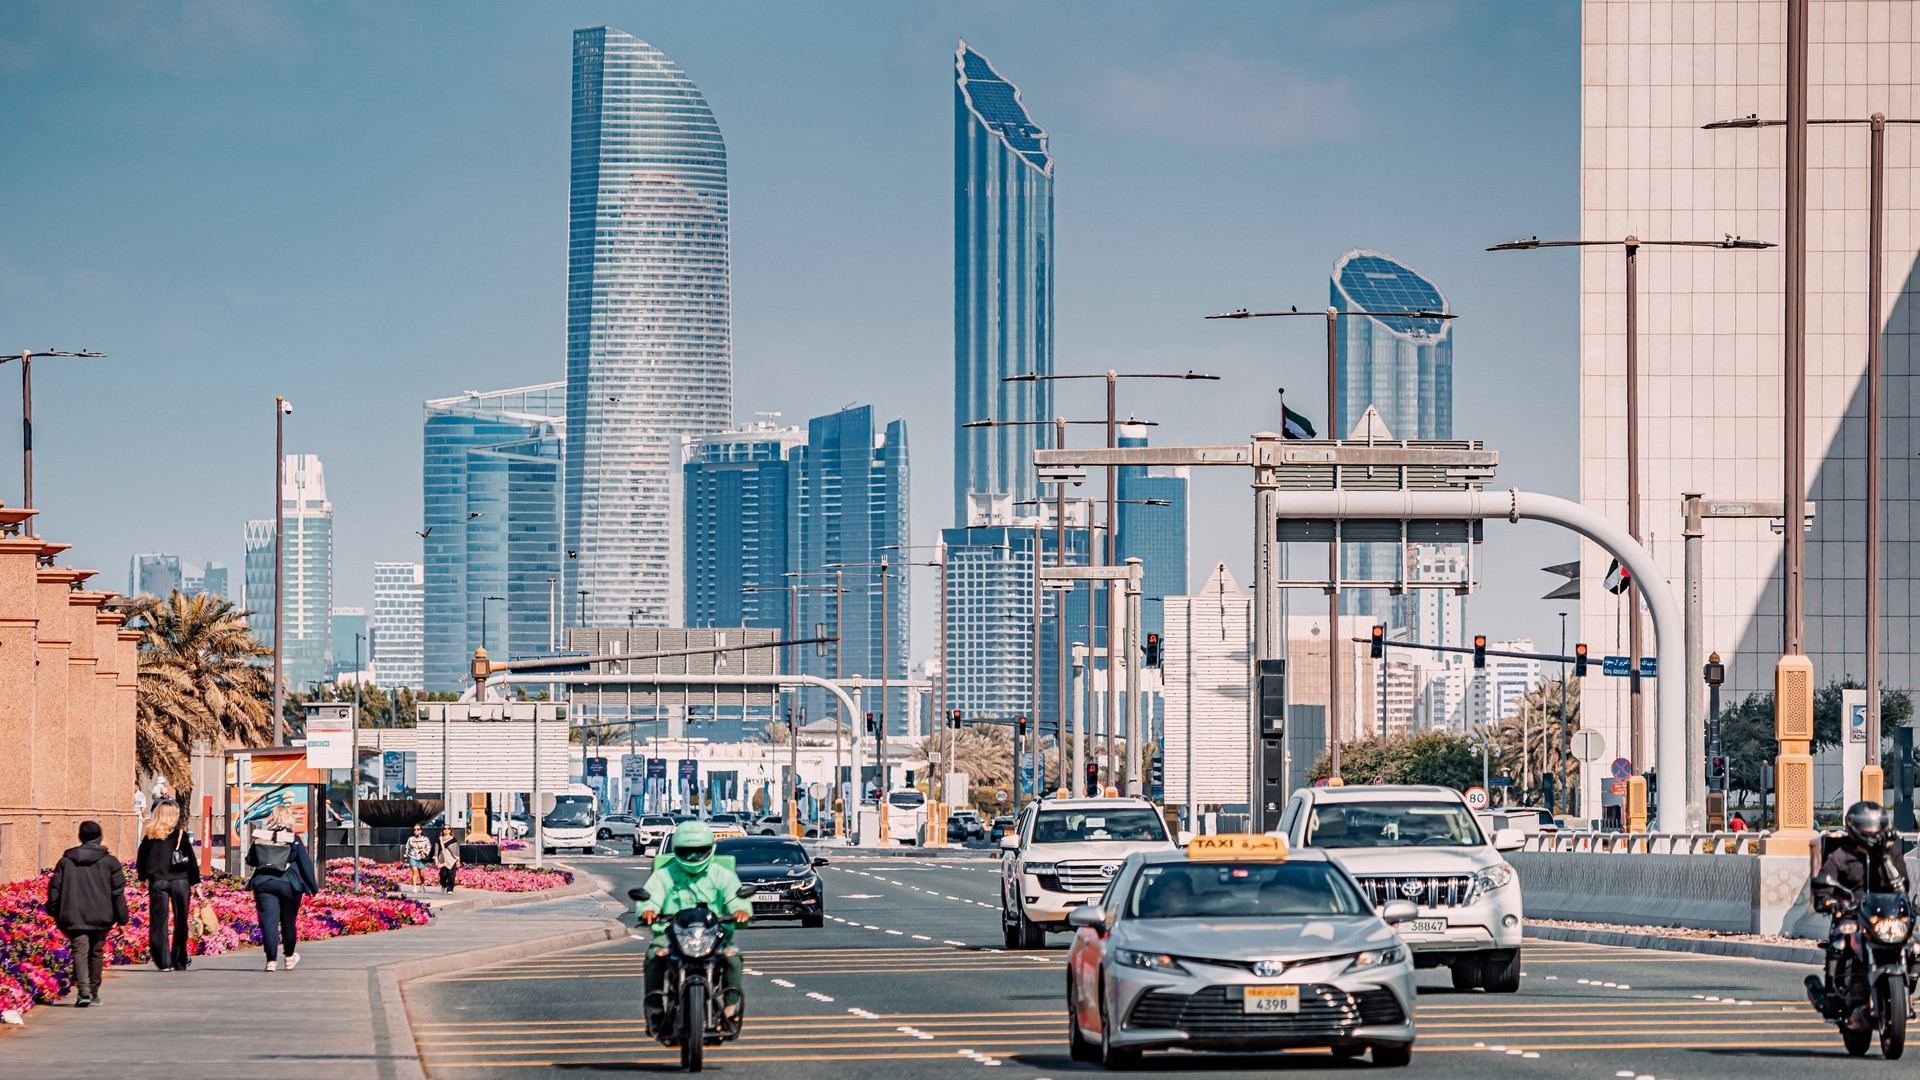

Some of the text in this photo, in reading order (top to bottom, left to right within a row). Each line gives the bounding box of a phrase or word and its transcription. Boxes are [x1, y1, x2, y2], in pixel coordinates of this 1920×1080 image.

[1470, 793, 1484, 803] 80
[1195, 838, 1278, 850] TAXI أجرة
[1411, 921, 1443, 931] 38847
[1256, 999, 1288, 1011] 4398
